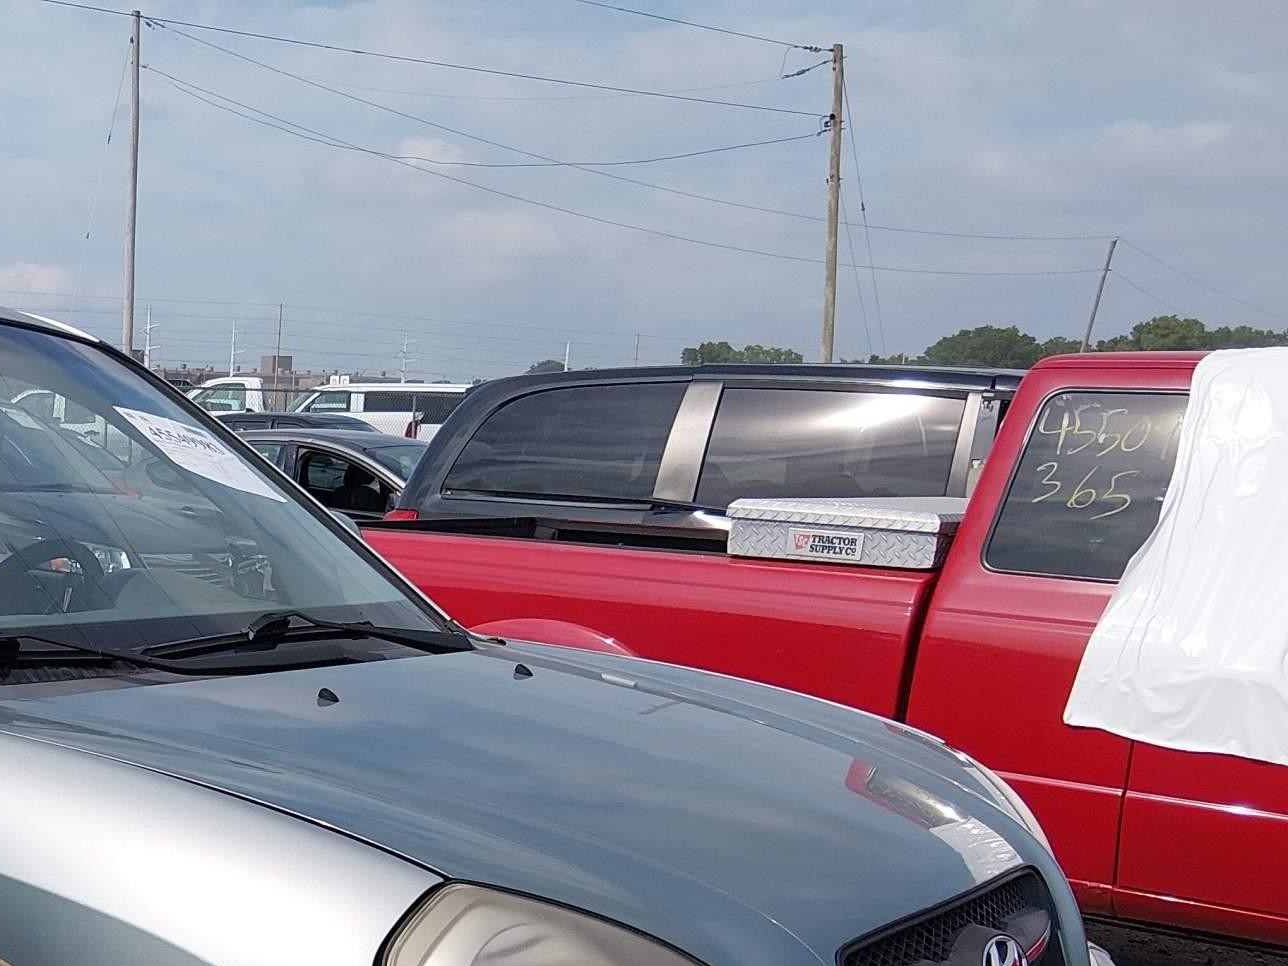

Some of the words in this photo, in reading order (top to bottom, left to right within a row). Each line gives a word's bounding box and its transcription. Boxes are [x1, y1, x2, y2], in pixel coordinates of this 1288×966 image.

[1032, 462, 1140, 519] 365
[812, 534, 858, 547] TRACTOR
[809, 544, 844, 555] SUPPLY
